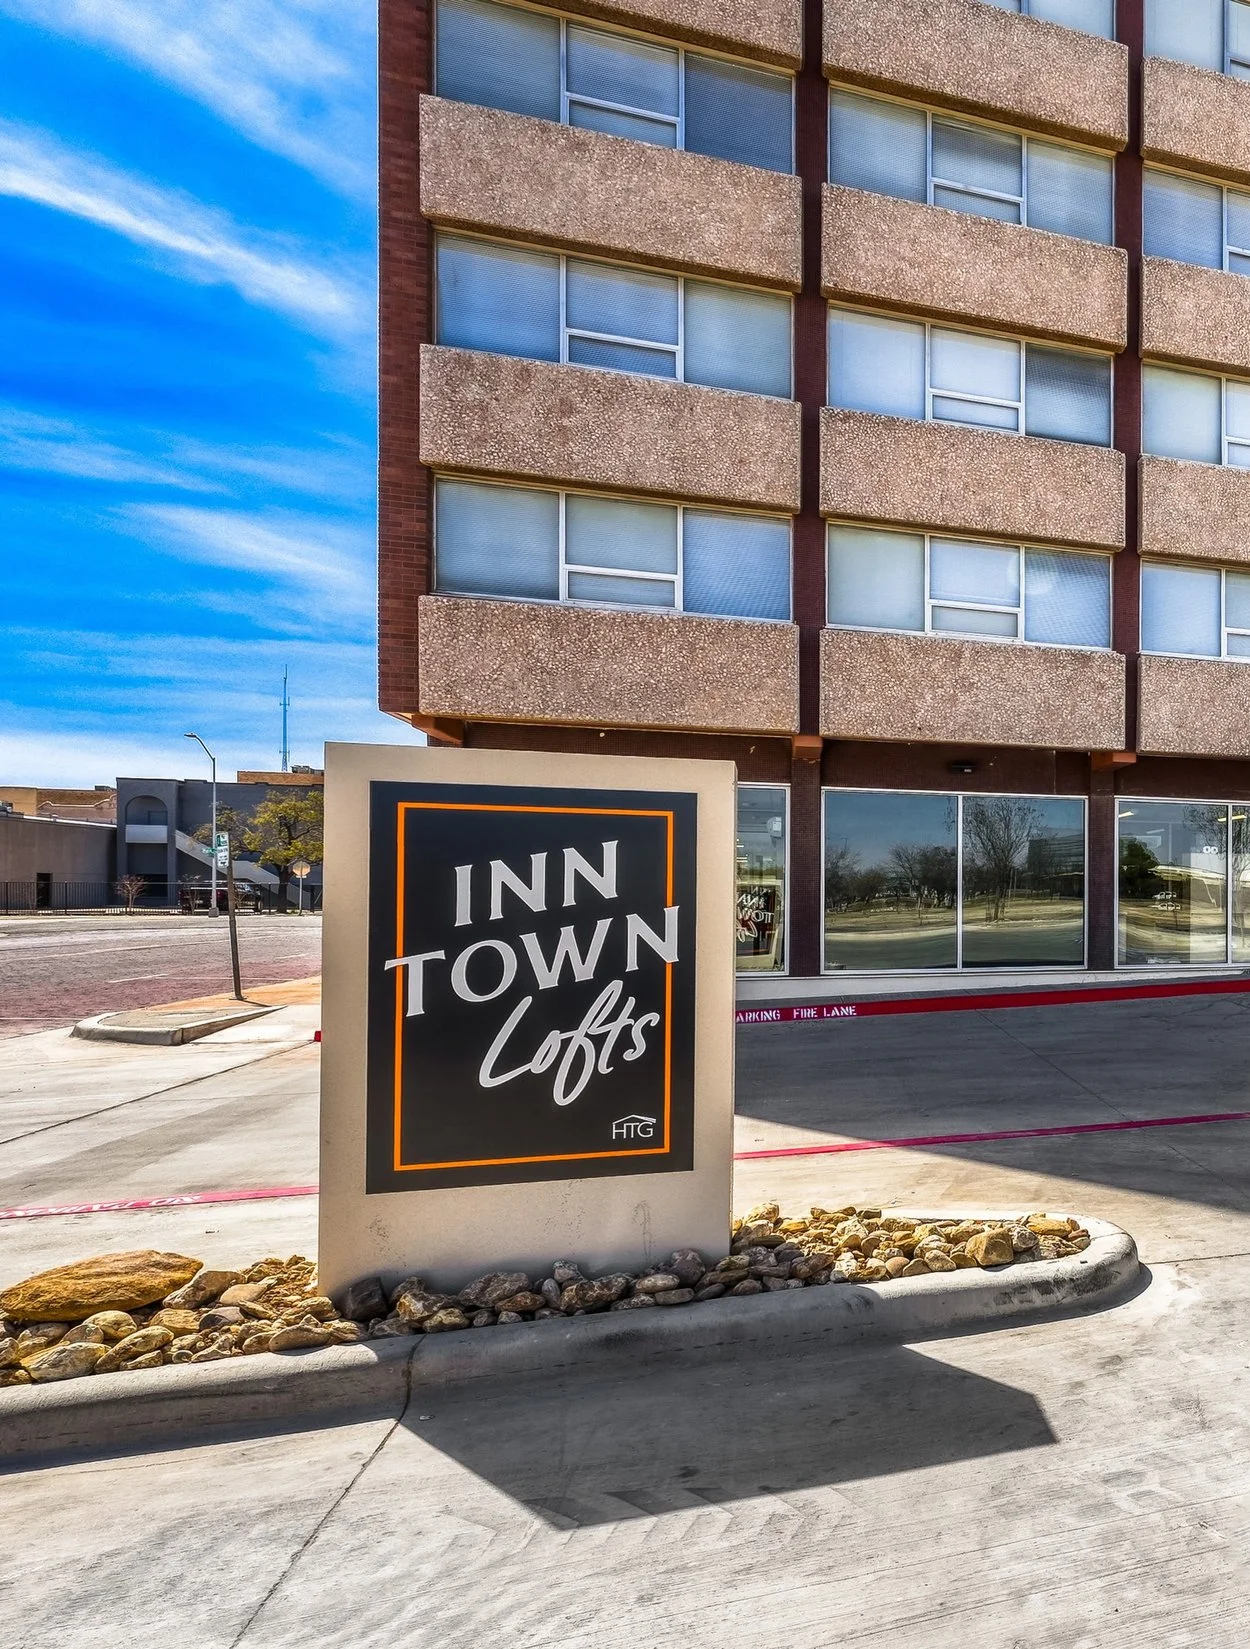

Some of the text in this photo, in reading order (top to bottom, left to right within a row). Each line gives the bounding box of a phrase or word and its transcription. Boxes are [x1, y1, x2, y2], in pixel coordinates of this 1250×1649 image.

[454, 840, 618, 927] INN
[384, 905, 680, 1017] TOWN
[479, 980, 660, 1106] Lofts
[736, 1005, 857, 1022] ARKING FIRE LANE
[612, 1121, 654, 1139] HTG
